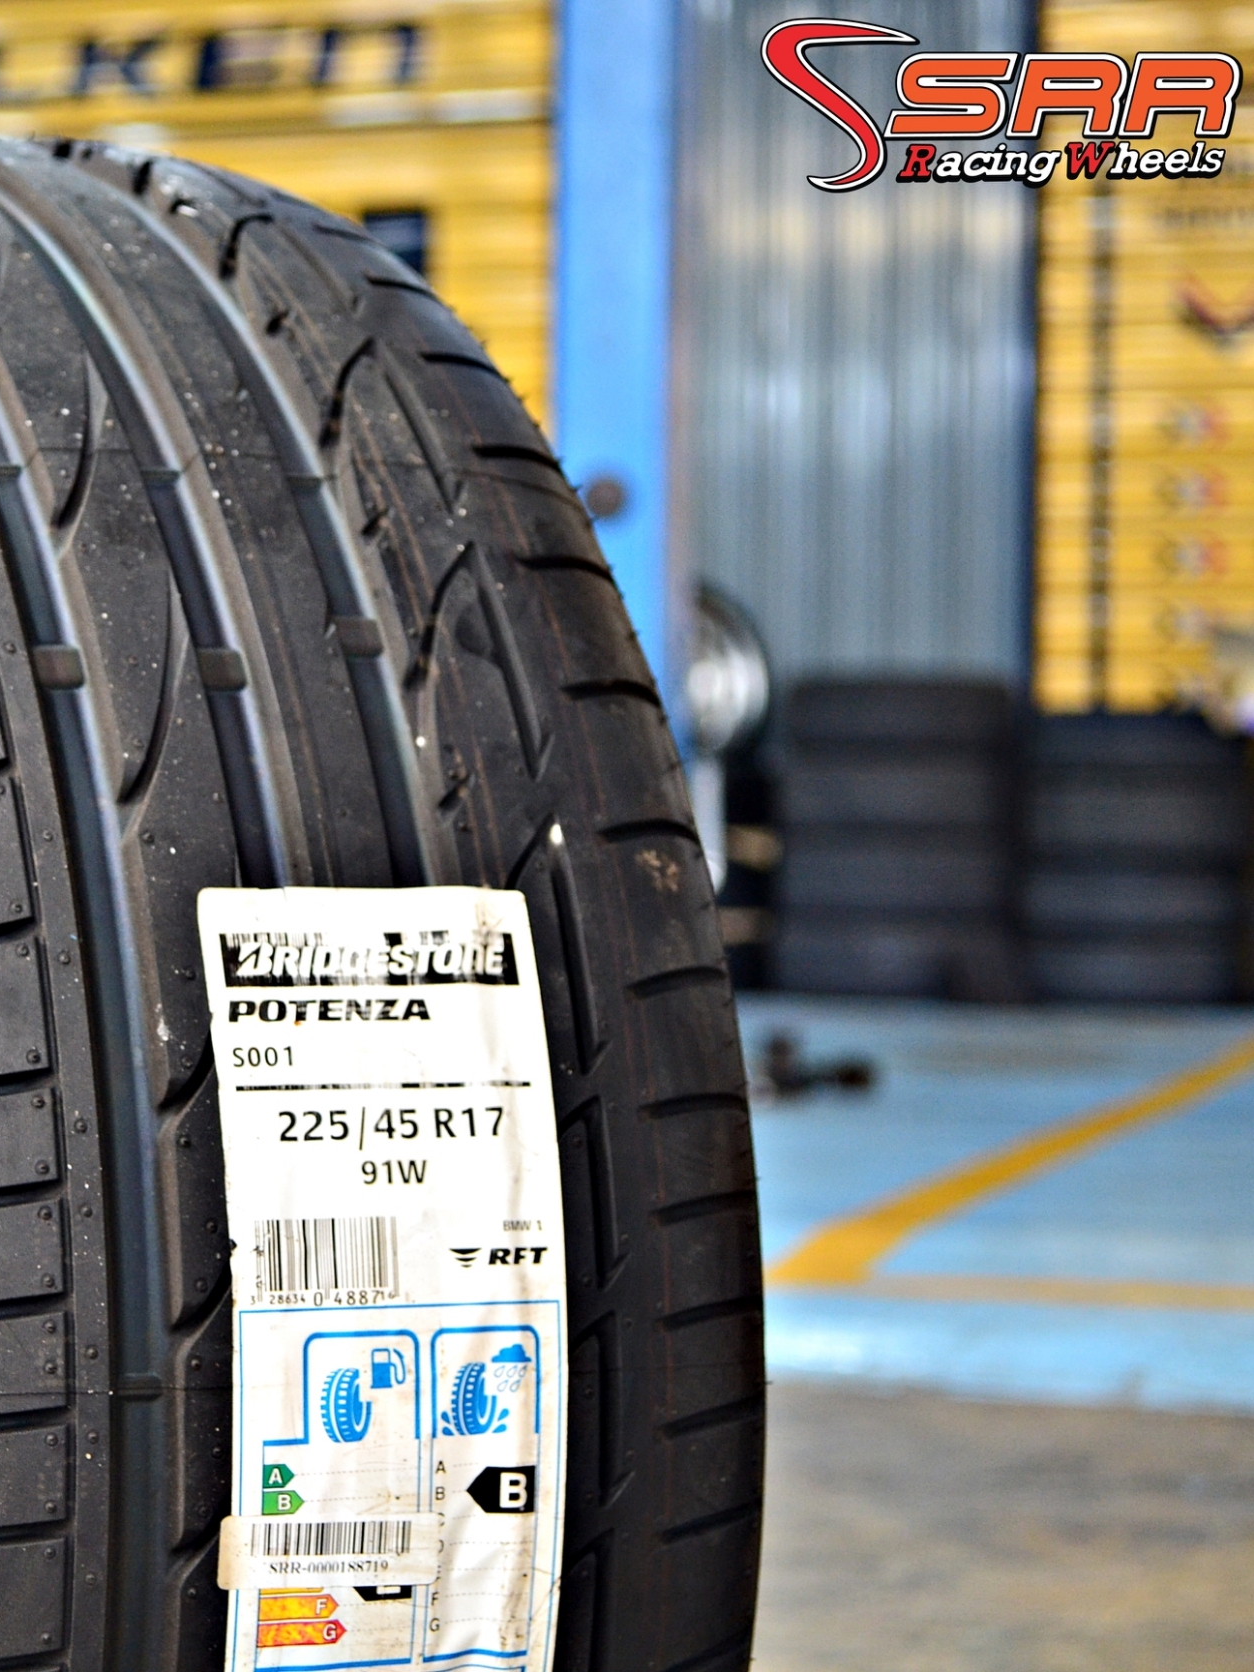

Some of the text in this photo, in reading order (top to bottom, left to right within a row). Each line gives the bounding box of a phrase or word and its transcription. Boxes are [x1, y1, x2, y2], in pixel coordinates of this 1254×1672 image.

[236, 941, 505, 978] BRIDGESTONE
[228, 999, 431, 1022] POTENZA
[232, 1046, 294, 1067] S001
[278, 1106, 504, 1151] 225/45 R17
[361, 1159, 427, 1185] 91W
[488, 1247, 548, 1265] RFT
[436, 1460, 446, 1474] A
[268, 1468, 283, 1485] A
[435, 1486, 446, 1501] B
[499, 1471, 528, 1509] B
[277, 1493, 292, 1511] B
[315, 1599, 328, 1615] F
[322, 1623, 337, 1641] G
[429, 1617, 440, 1632] G
